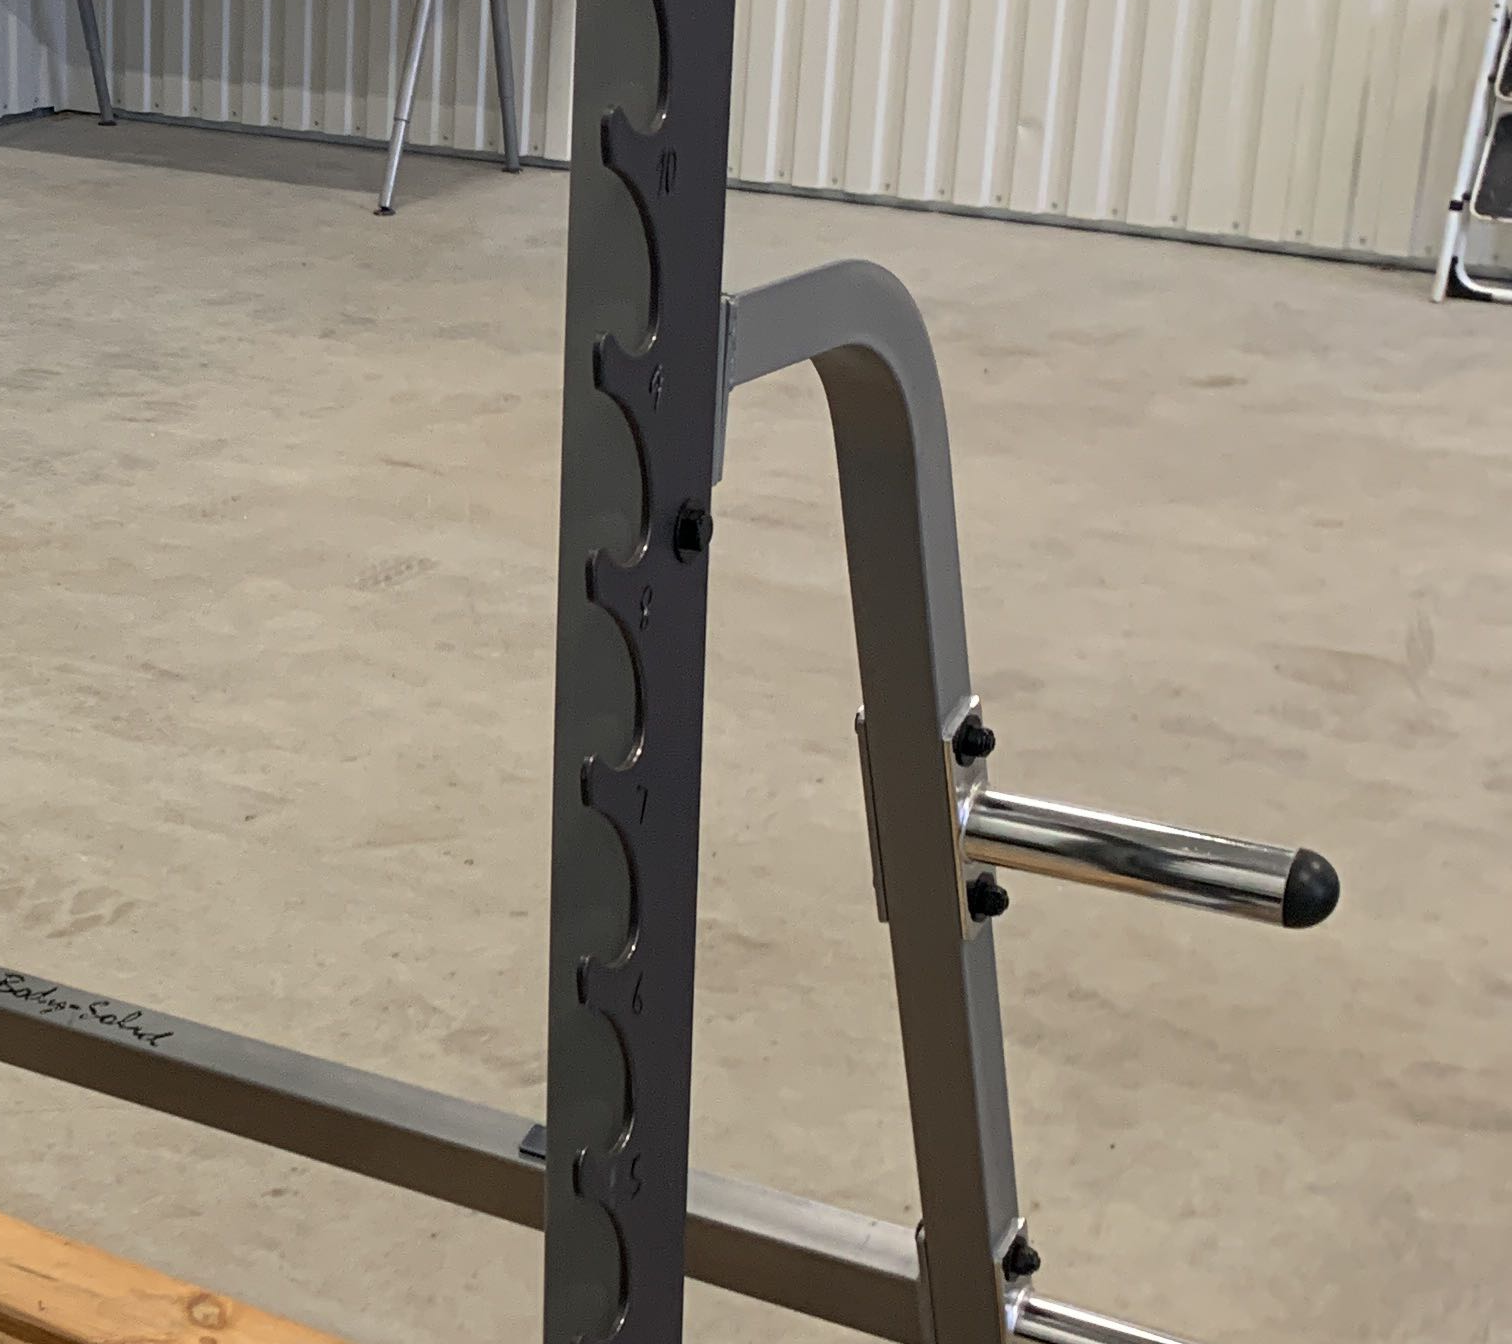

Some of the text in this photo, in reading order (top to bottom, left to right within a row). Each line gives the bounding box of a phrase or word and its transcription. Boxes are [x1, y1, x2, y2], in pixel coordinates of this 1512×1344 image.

[656, 146, 678, 195] 10
[647, 361, 663, 411] 9
[639, 584, 653, 632] 8
[635, 784, 649, 826] 7
[631, 970, 644, 1016] 6
[630, 1153, 642, 1201] 5
